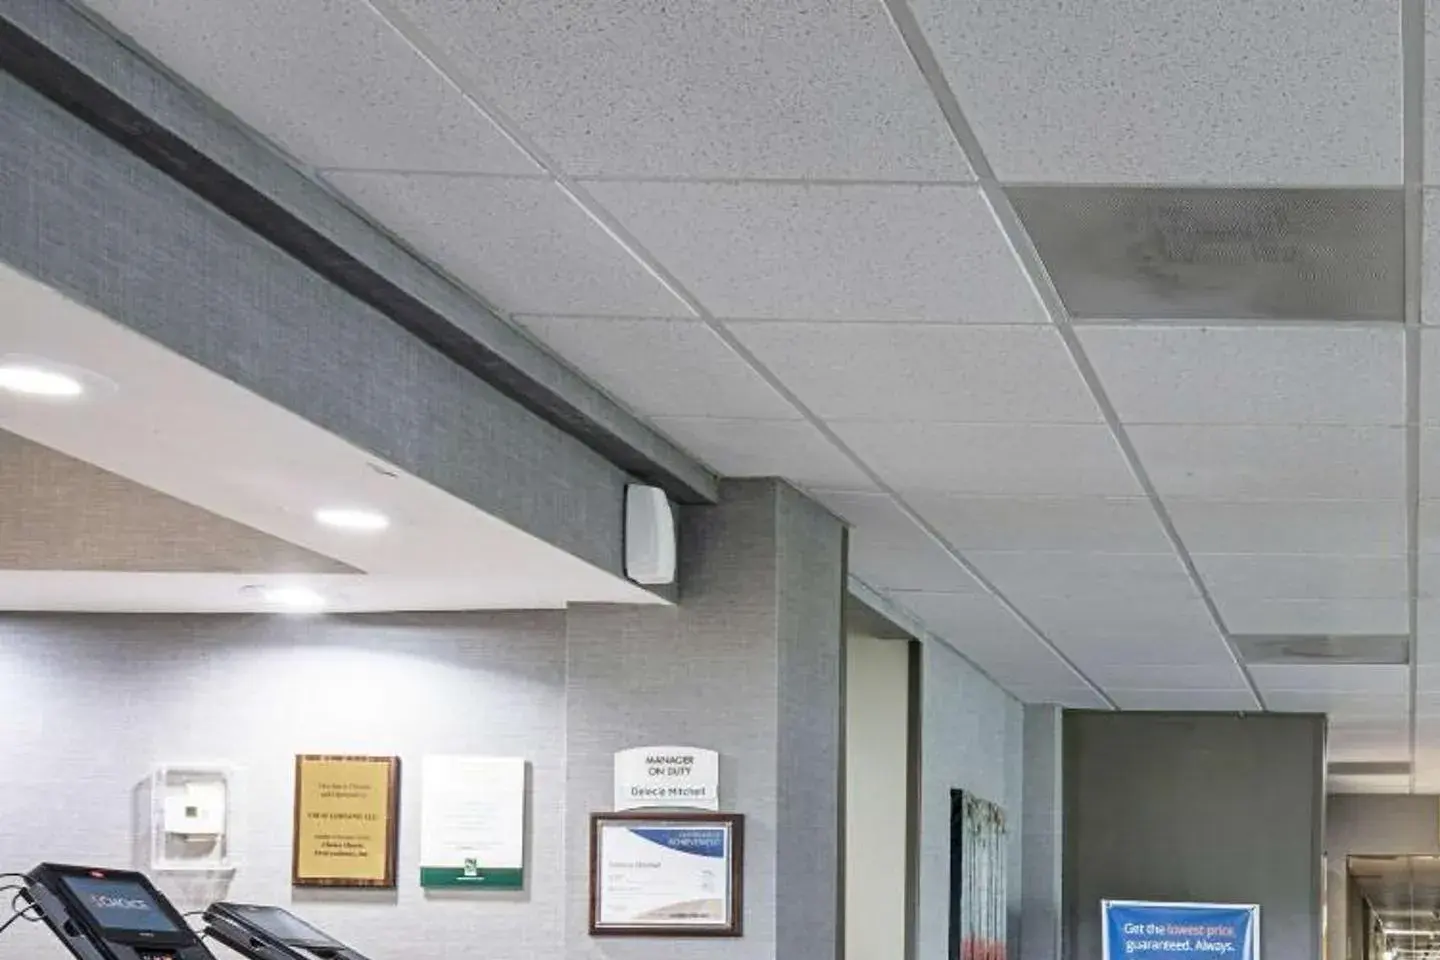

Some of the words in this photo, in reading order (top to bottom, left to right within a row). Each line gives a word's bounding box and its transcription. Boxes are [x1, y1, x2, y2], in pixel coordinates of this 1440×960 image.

[645, 755, 694, 765] MANAGER
[648, 767, 666, 776] ON
[667, 767, 692, 776] DUTY
[1124, 922, 1144, 934] Get
[1146, 922, 1165, 934] the
[1167, 923, 1205, 935] lowest
[1125, 939, 1193, 953] guaranteed.
[1195, 940, 1236, 955] Always.
